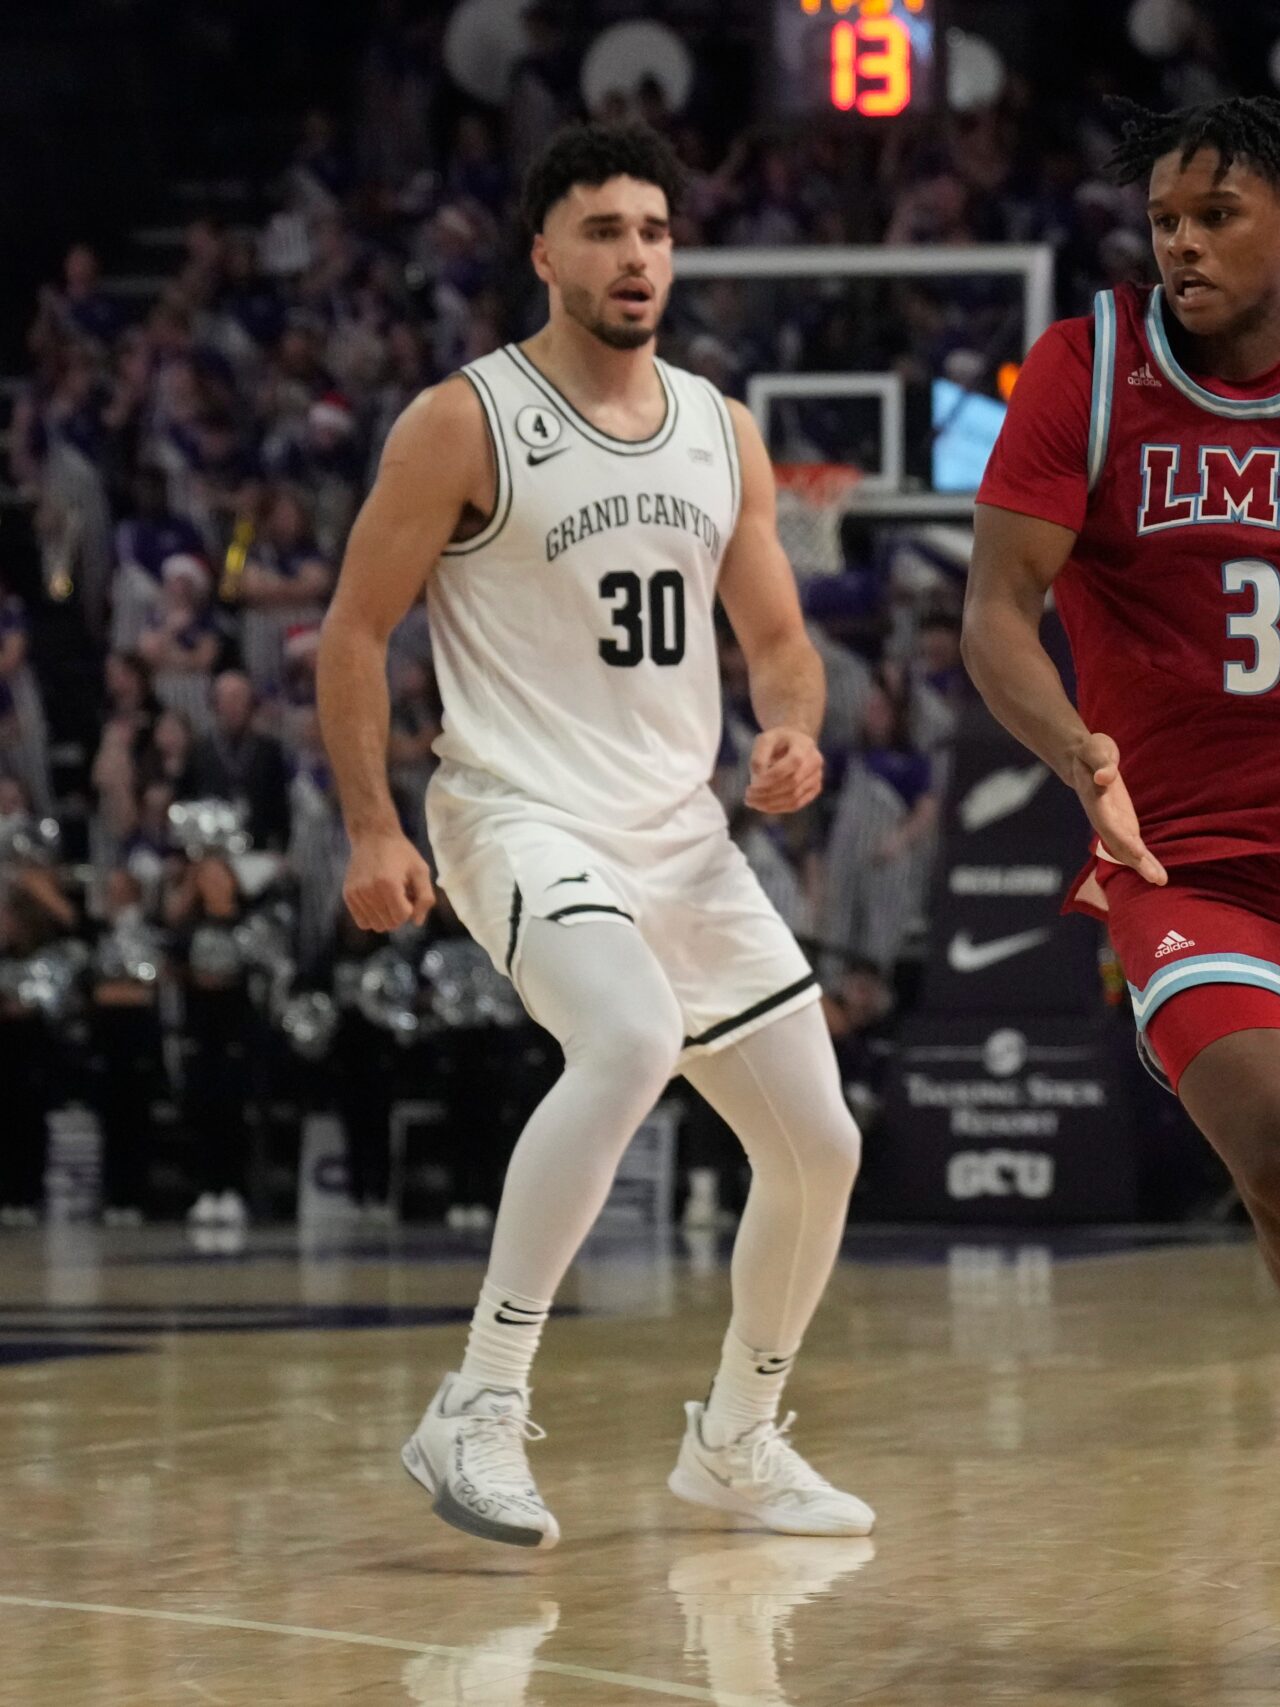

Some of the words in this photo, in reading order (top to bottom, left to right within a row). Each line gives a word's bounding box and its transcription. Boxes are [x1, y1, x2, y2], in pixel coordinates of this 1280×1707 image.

[831, 20, 911, 117] 13
[1127, 376, 1162, 388] adidas
[532, 413, 549, 439] 4
[546, 494, 628, 562] GRAND
[637, 493, 721, 561] CANYON
[599, 569, 686, 668] 30
[1154, 938, 1196, 958] adidas
[946, 1149, 1055, 1200] GCU
